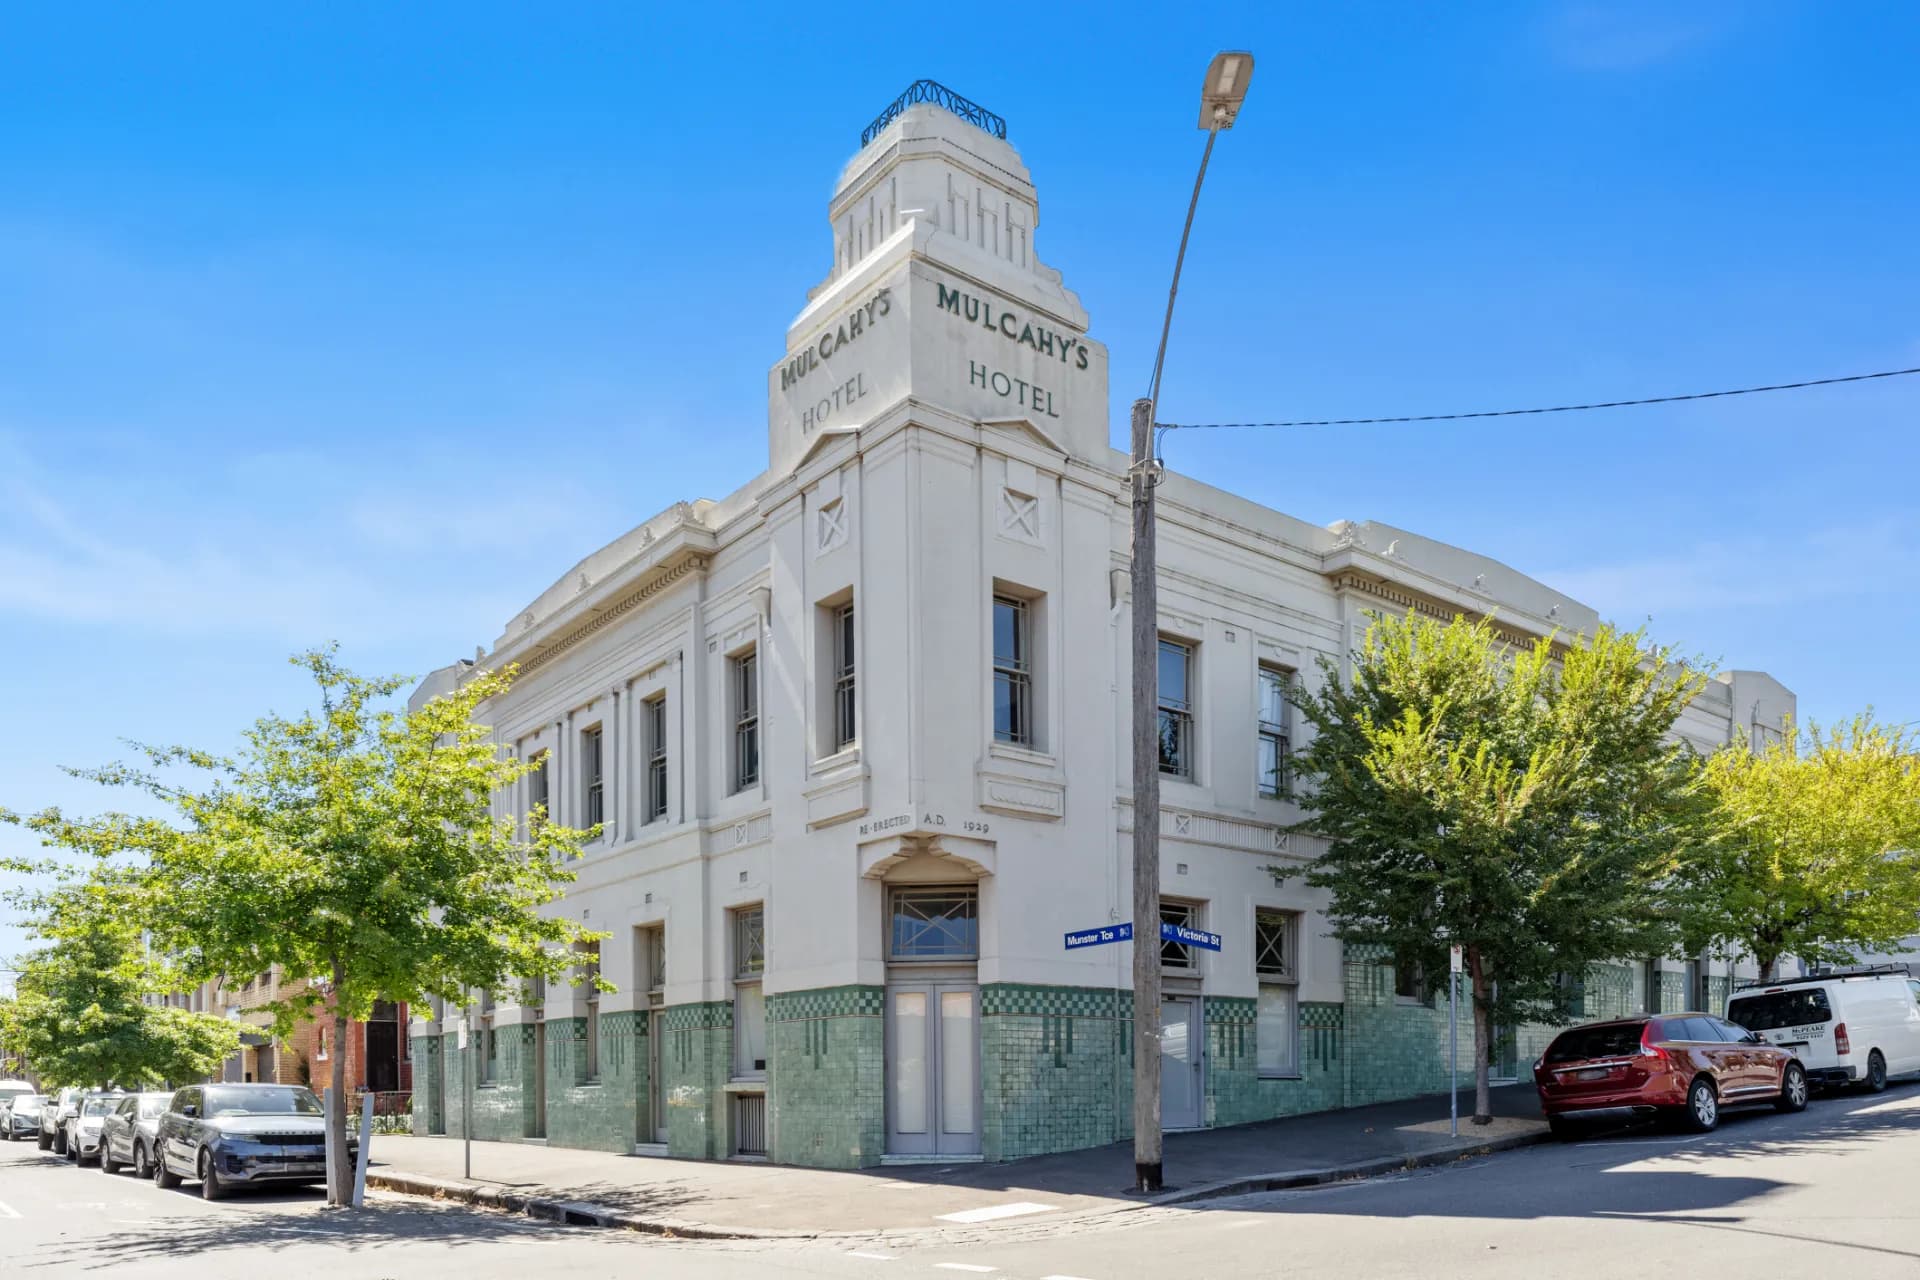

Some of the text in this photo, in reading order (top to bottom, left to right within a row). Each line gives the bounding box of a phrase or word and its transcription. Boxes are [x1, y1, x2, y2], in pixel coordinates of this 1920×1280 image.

[781, 287, 892, 391] MULCAHY'S
[936, 282, 1089, 370] MULCAHY'S
[802, 372, 867, 435] HOTEL
[968, 360, 1060, 418] HOTEL
[1067, 930, 1114, 946] Munster Tce
[1177, 927, 1220, 946] Victoria St
